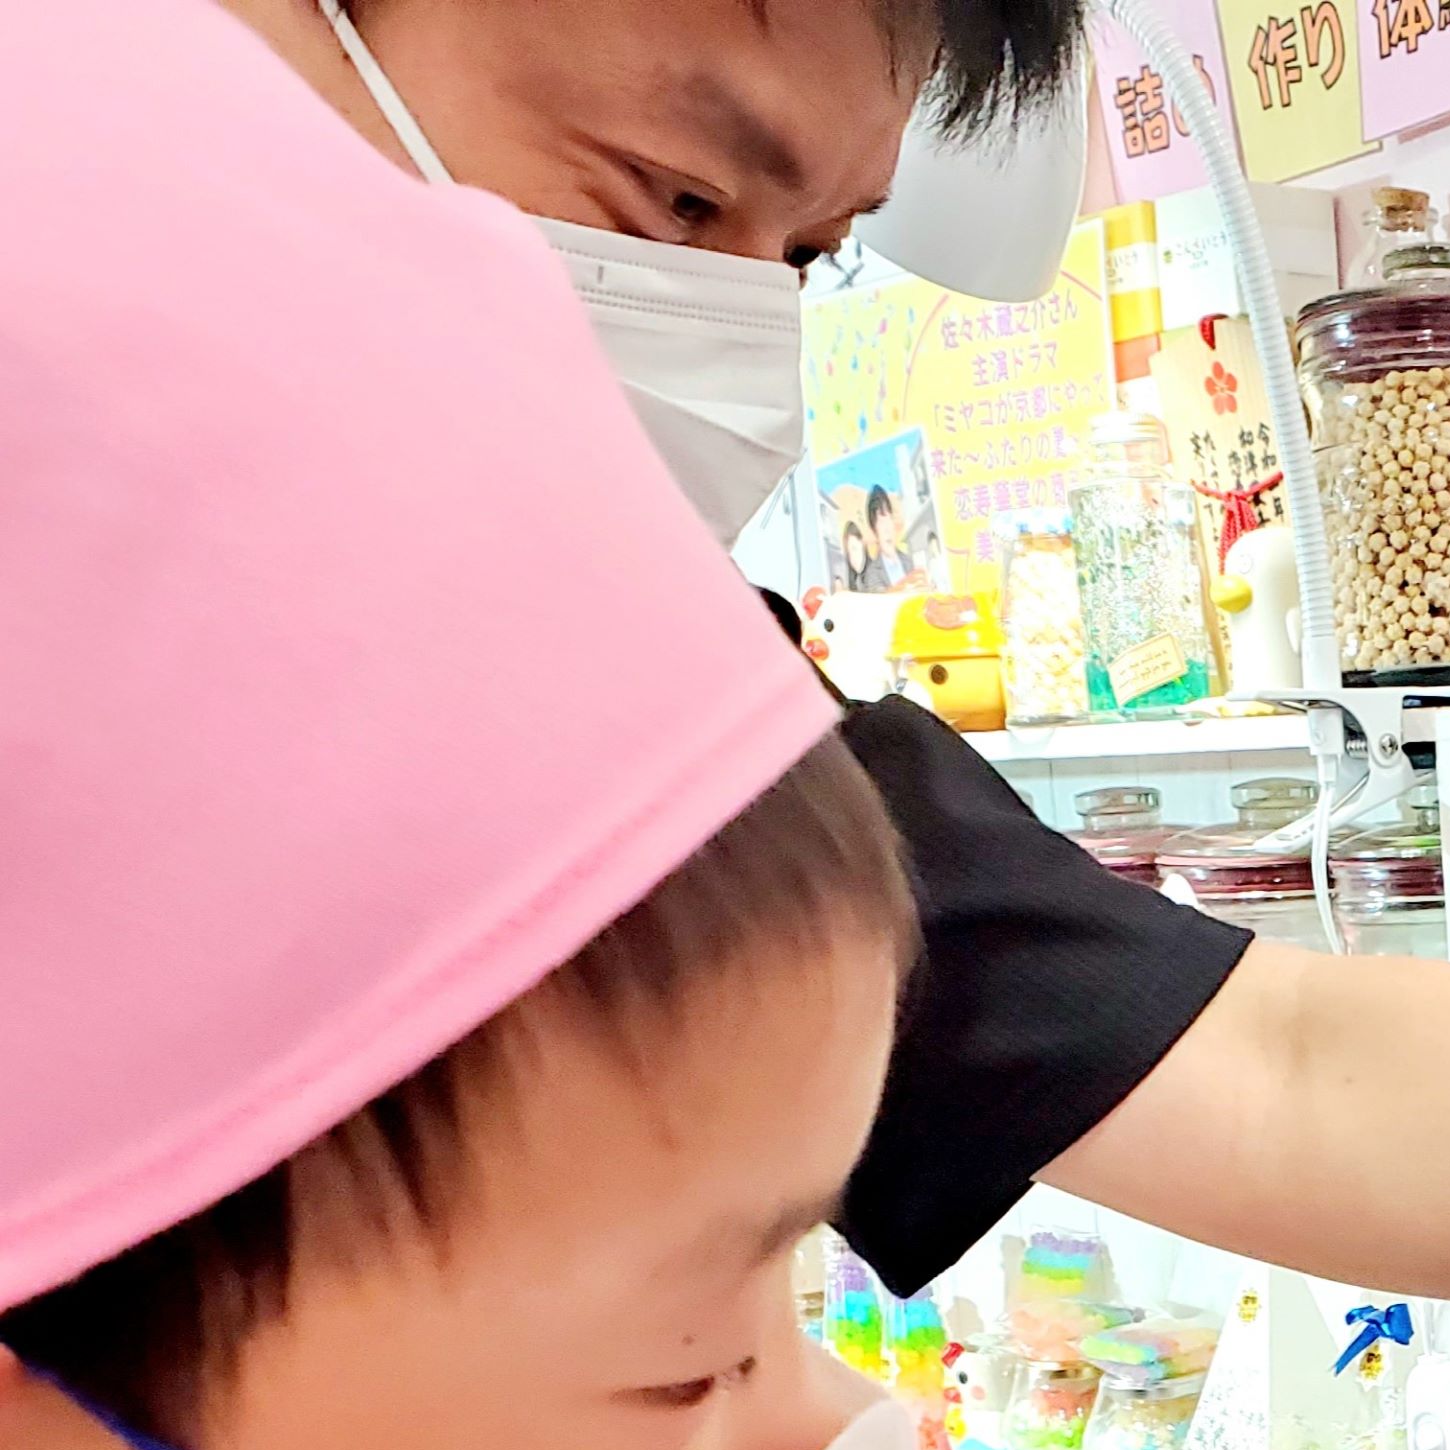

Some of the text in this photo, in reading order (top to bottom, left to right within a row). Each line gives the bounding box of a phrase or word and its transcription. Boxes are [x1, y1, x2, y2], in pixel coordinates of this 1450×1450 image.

[1248, 1, 1346, 108] 作り
[972, 342, 1057, 386] 主演ドラマ
